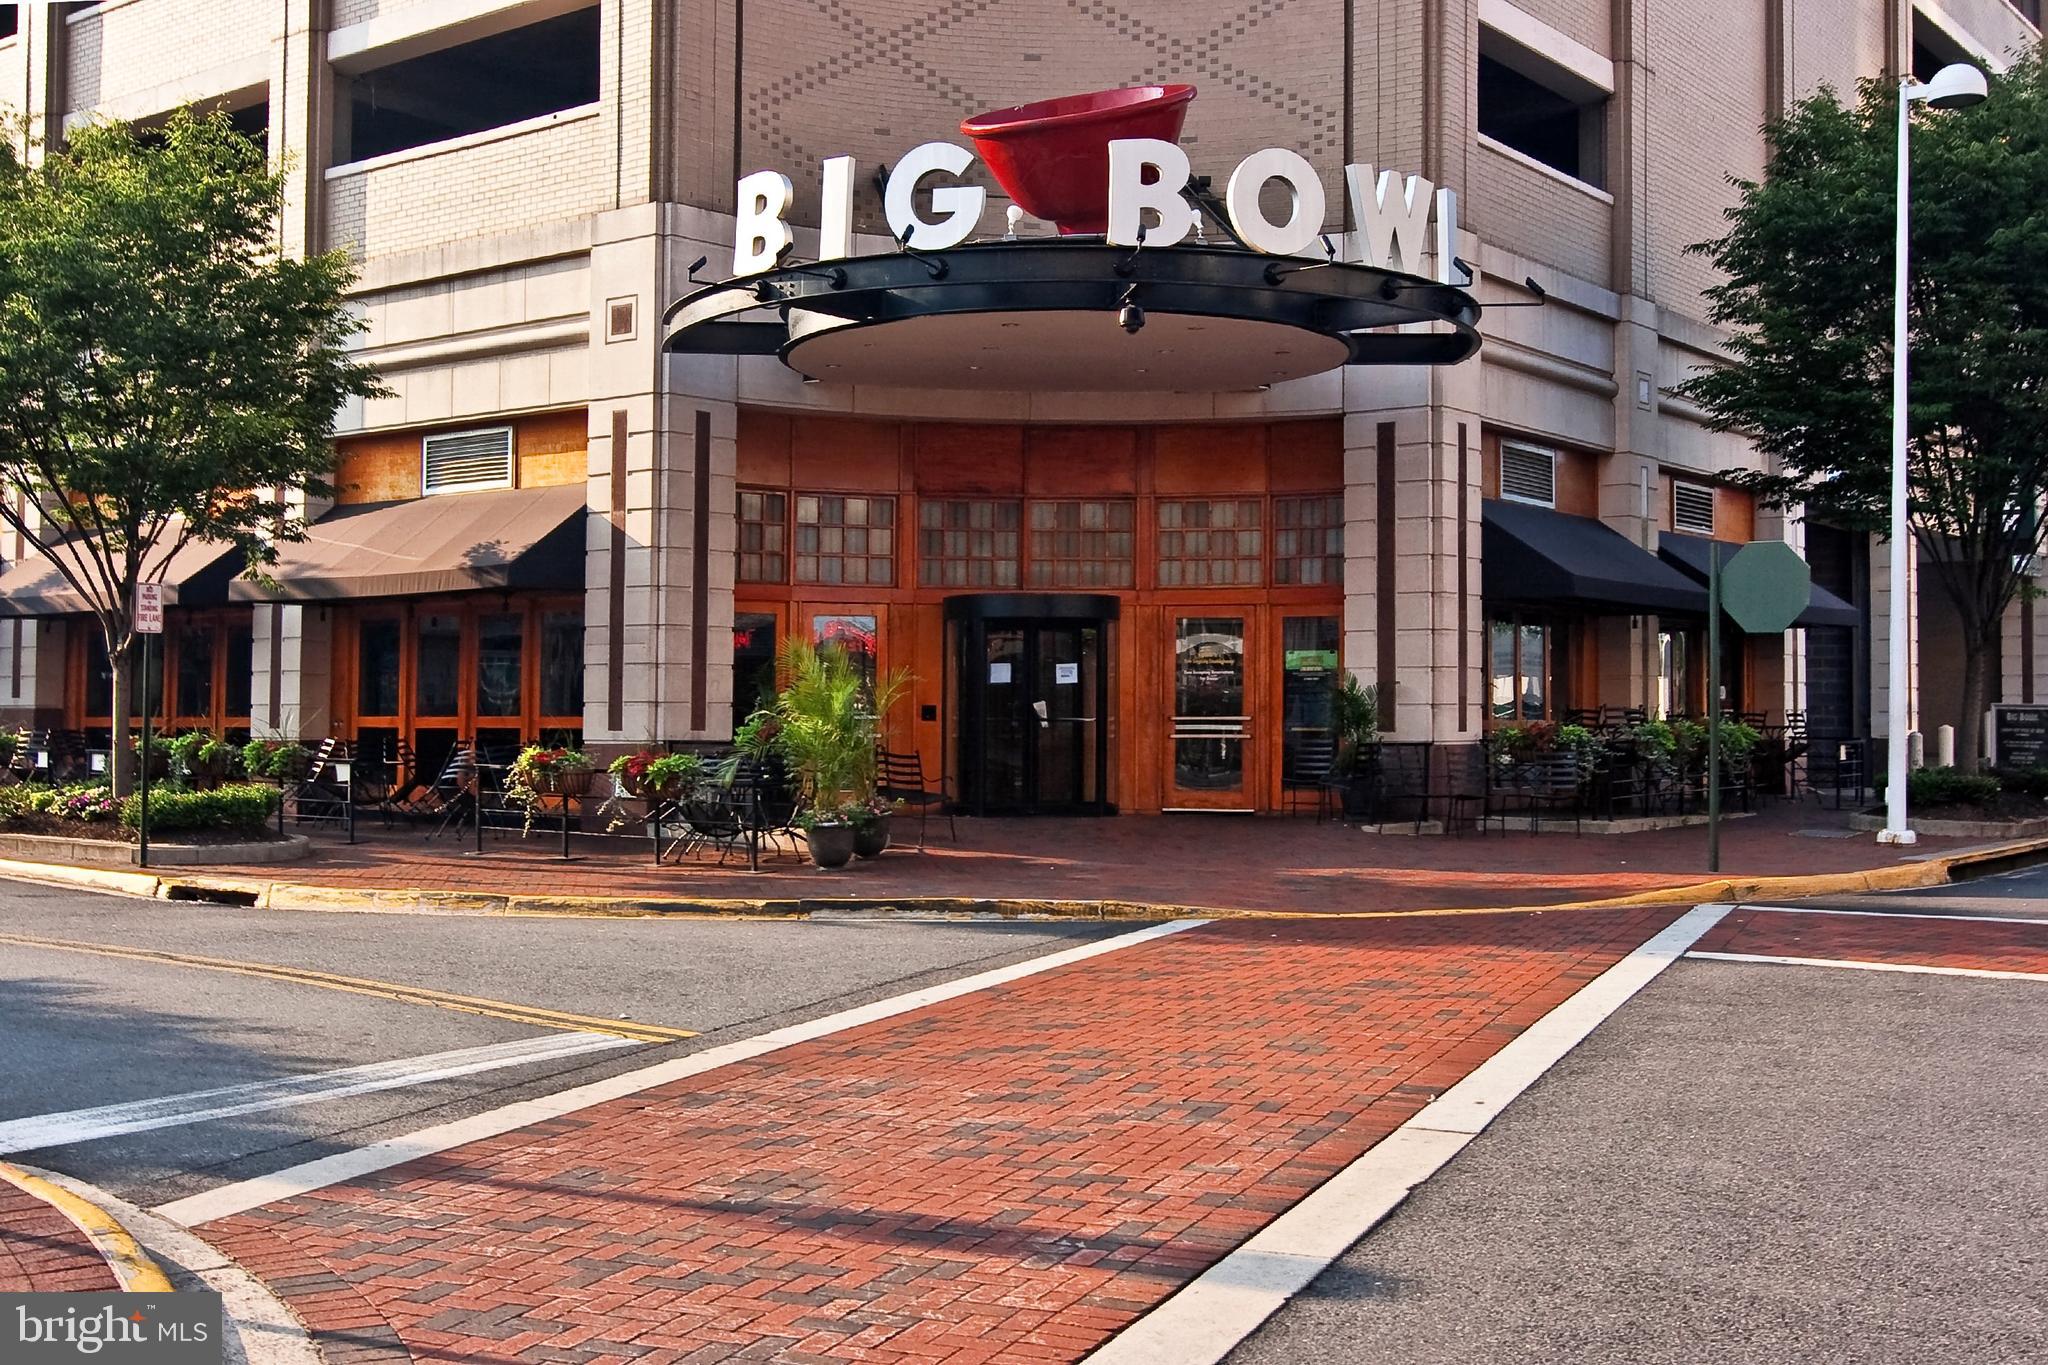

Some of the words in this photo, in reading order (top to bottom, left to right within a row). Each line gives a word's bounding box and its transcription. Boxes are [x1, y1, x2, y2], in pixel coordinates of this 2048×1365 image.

[733, 141, 986, 276] BIG
[1107, 138, 1470, 286] BOWL
[137, 613, 148, 622] FIRE
[149, 613, 162, 622] LANE
